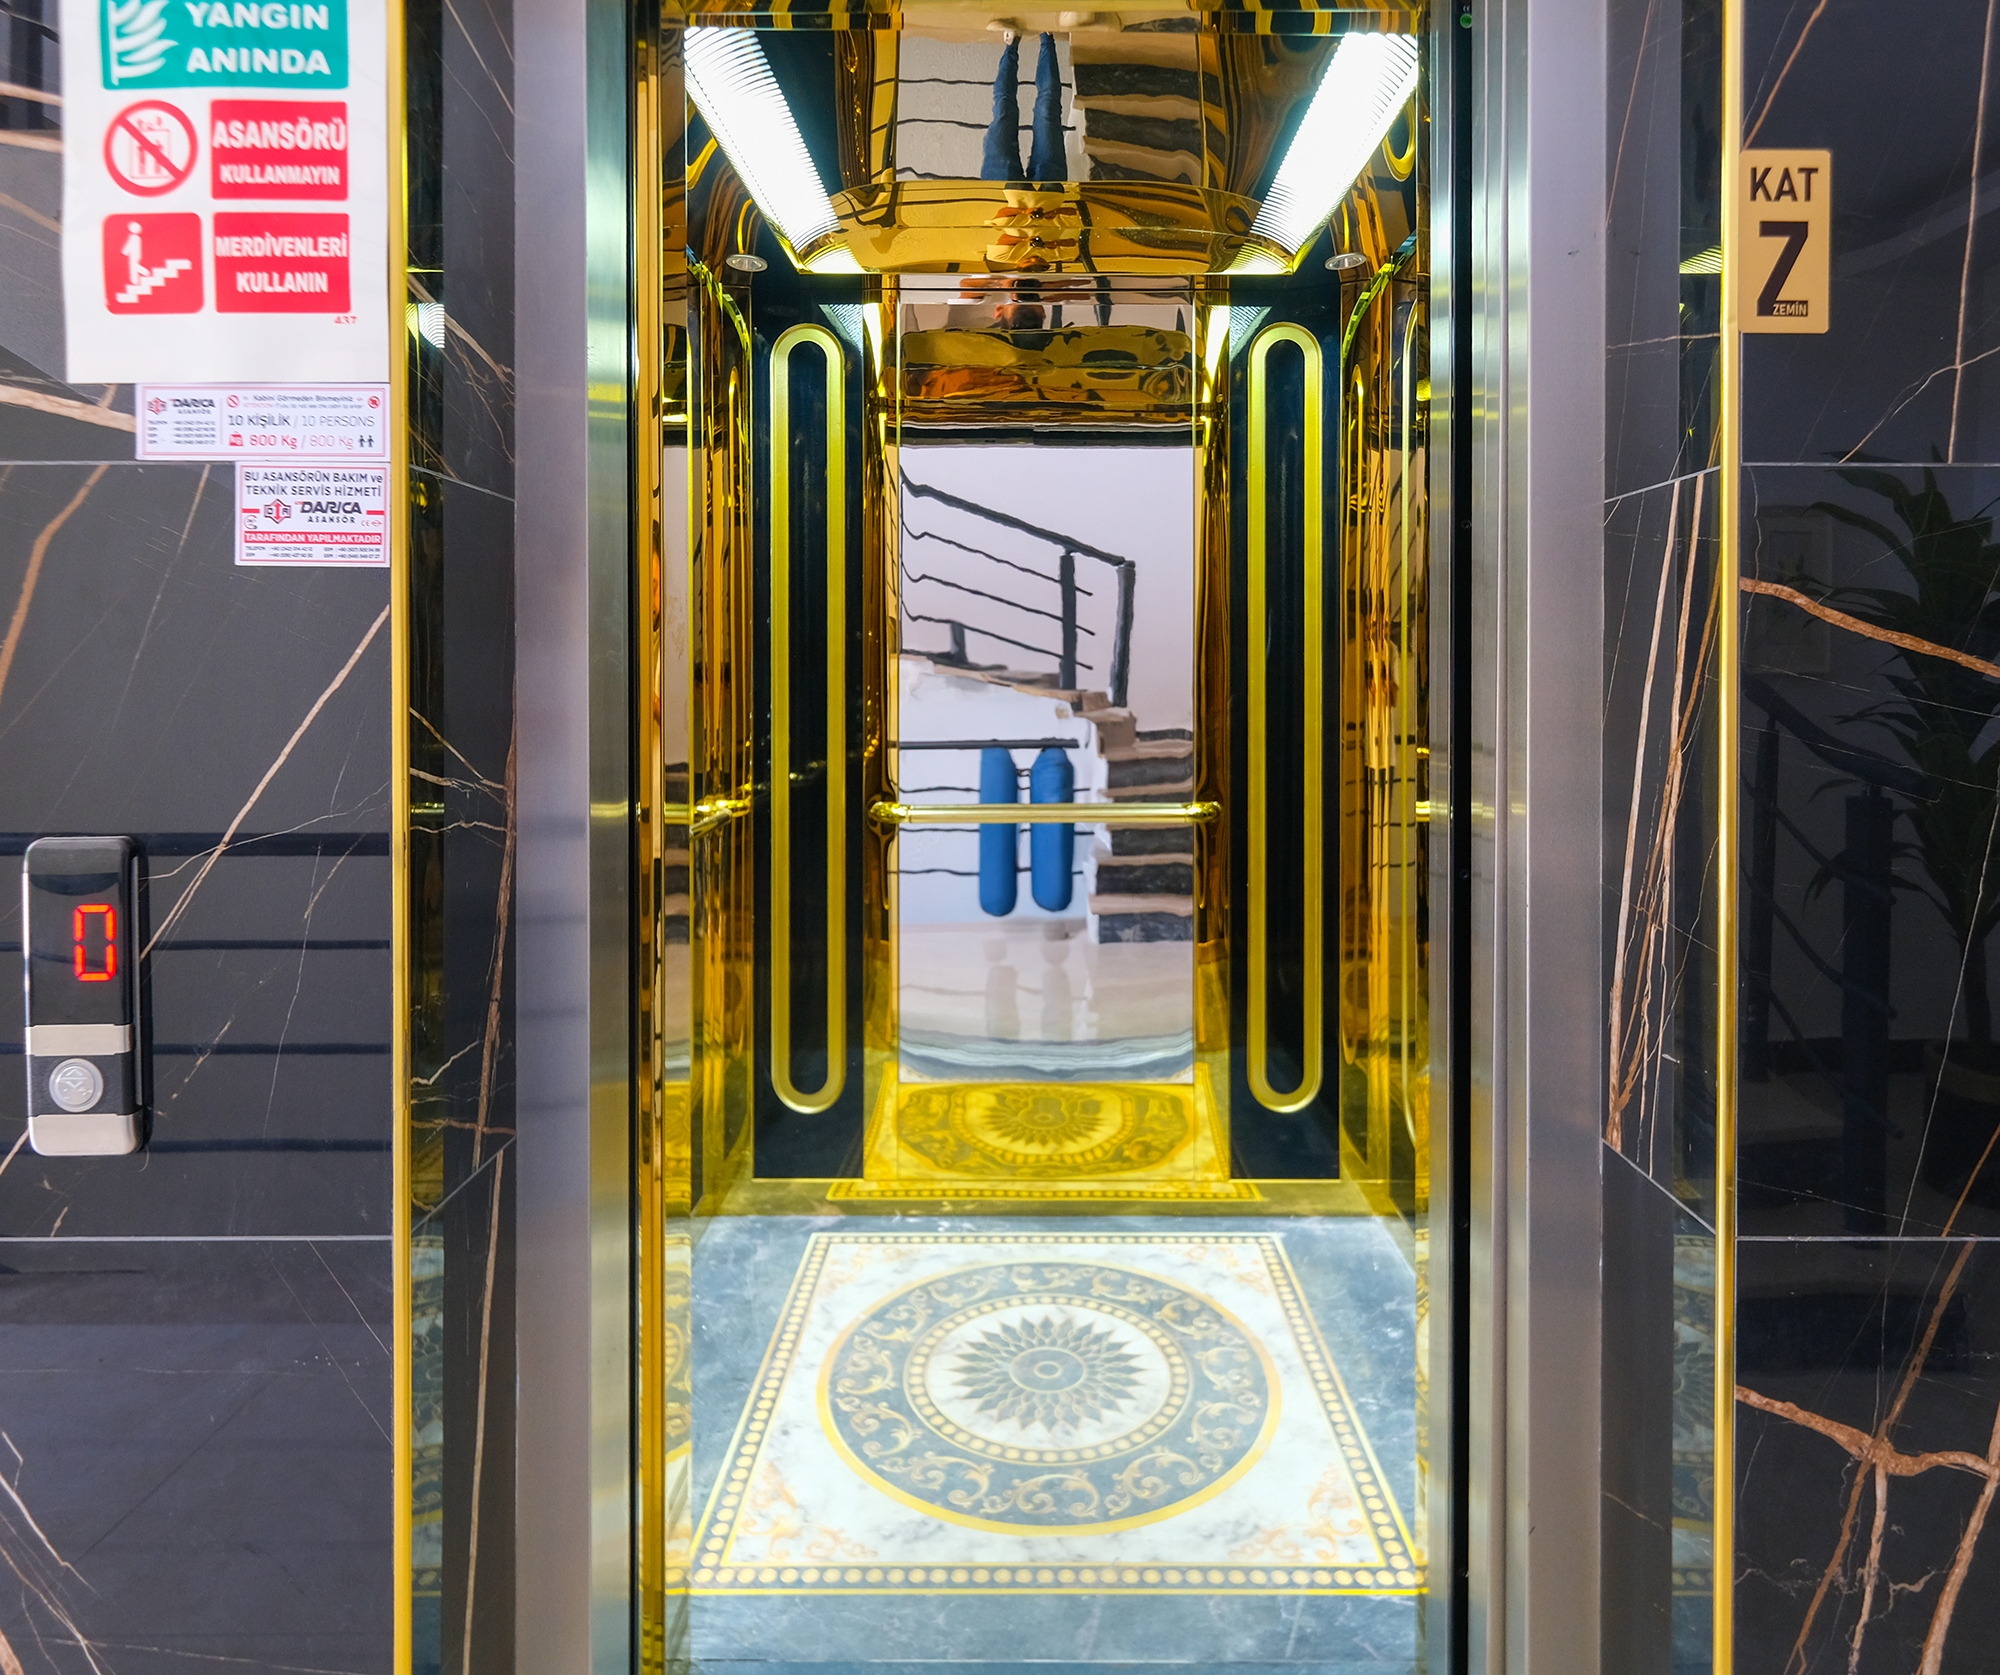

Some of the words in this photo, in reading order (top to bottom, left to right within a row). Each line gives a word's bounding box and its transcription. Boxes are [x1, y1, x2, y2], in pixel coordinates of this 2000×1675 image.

[185, 2, 329, 30] YANGIN
[186, 47, 332, 75] ANINDA
[213, 117, 347, 150] ASANSÖRÜ
[220, 164, 340, 185] KULLANMAYIN
[1750, 167, 1818, 202] KAT
[215, 231, 347, 257] MERDİVENLERİ
[1756, 221, 1808, 317] Z
[236, 271, 329, 293] KULLANIN
[1772, 302, 1807, 316] ZEMİN
[228, 415, 244, 426] 10
[247, 412, 291, 429] KİŞİLİK
[302, 415, 316, 427] 10
[320, 415, 375, 427] PERSONS
[249, 435, 276, 446] 800
[282, 434, 297, 450] Kg
[310, 435, 334, 447] 800
[340, 435, 354, 450] Kg
[244, 471, 259, 481] BU
[262, 470, 330, 483] ASANSÖRÜN
[333, 472, 367, 483] BAKIM
[371, 475, 383, 483] ve
[246, 484, 288, 496] TEKNİK
[291, 484, 331, 496] SERVİS
[334, 484, 381, 497] HİZMETİ
[300, 501, 362, 514] DARICA
[307, 515, 356, 523] ASANSÖR
[245, 533, 305, 543] TARAFINDAN
[307, 534, 381, 544] YAPILMAKTADIR
[73, 903, 117, 982] 0
